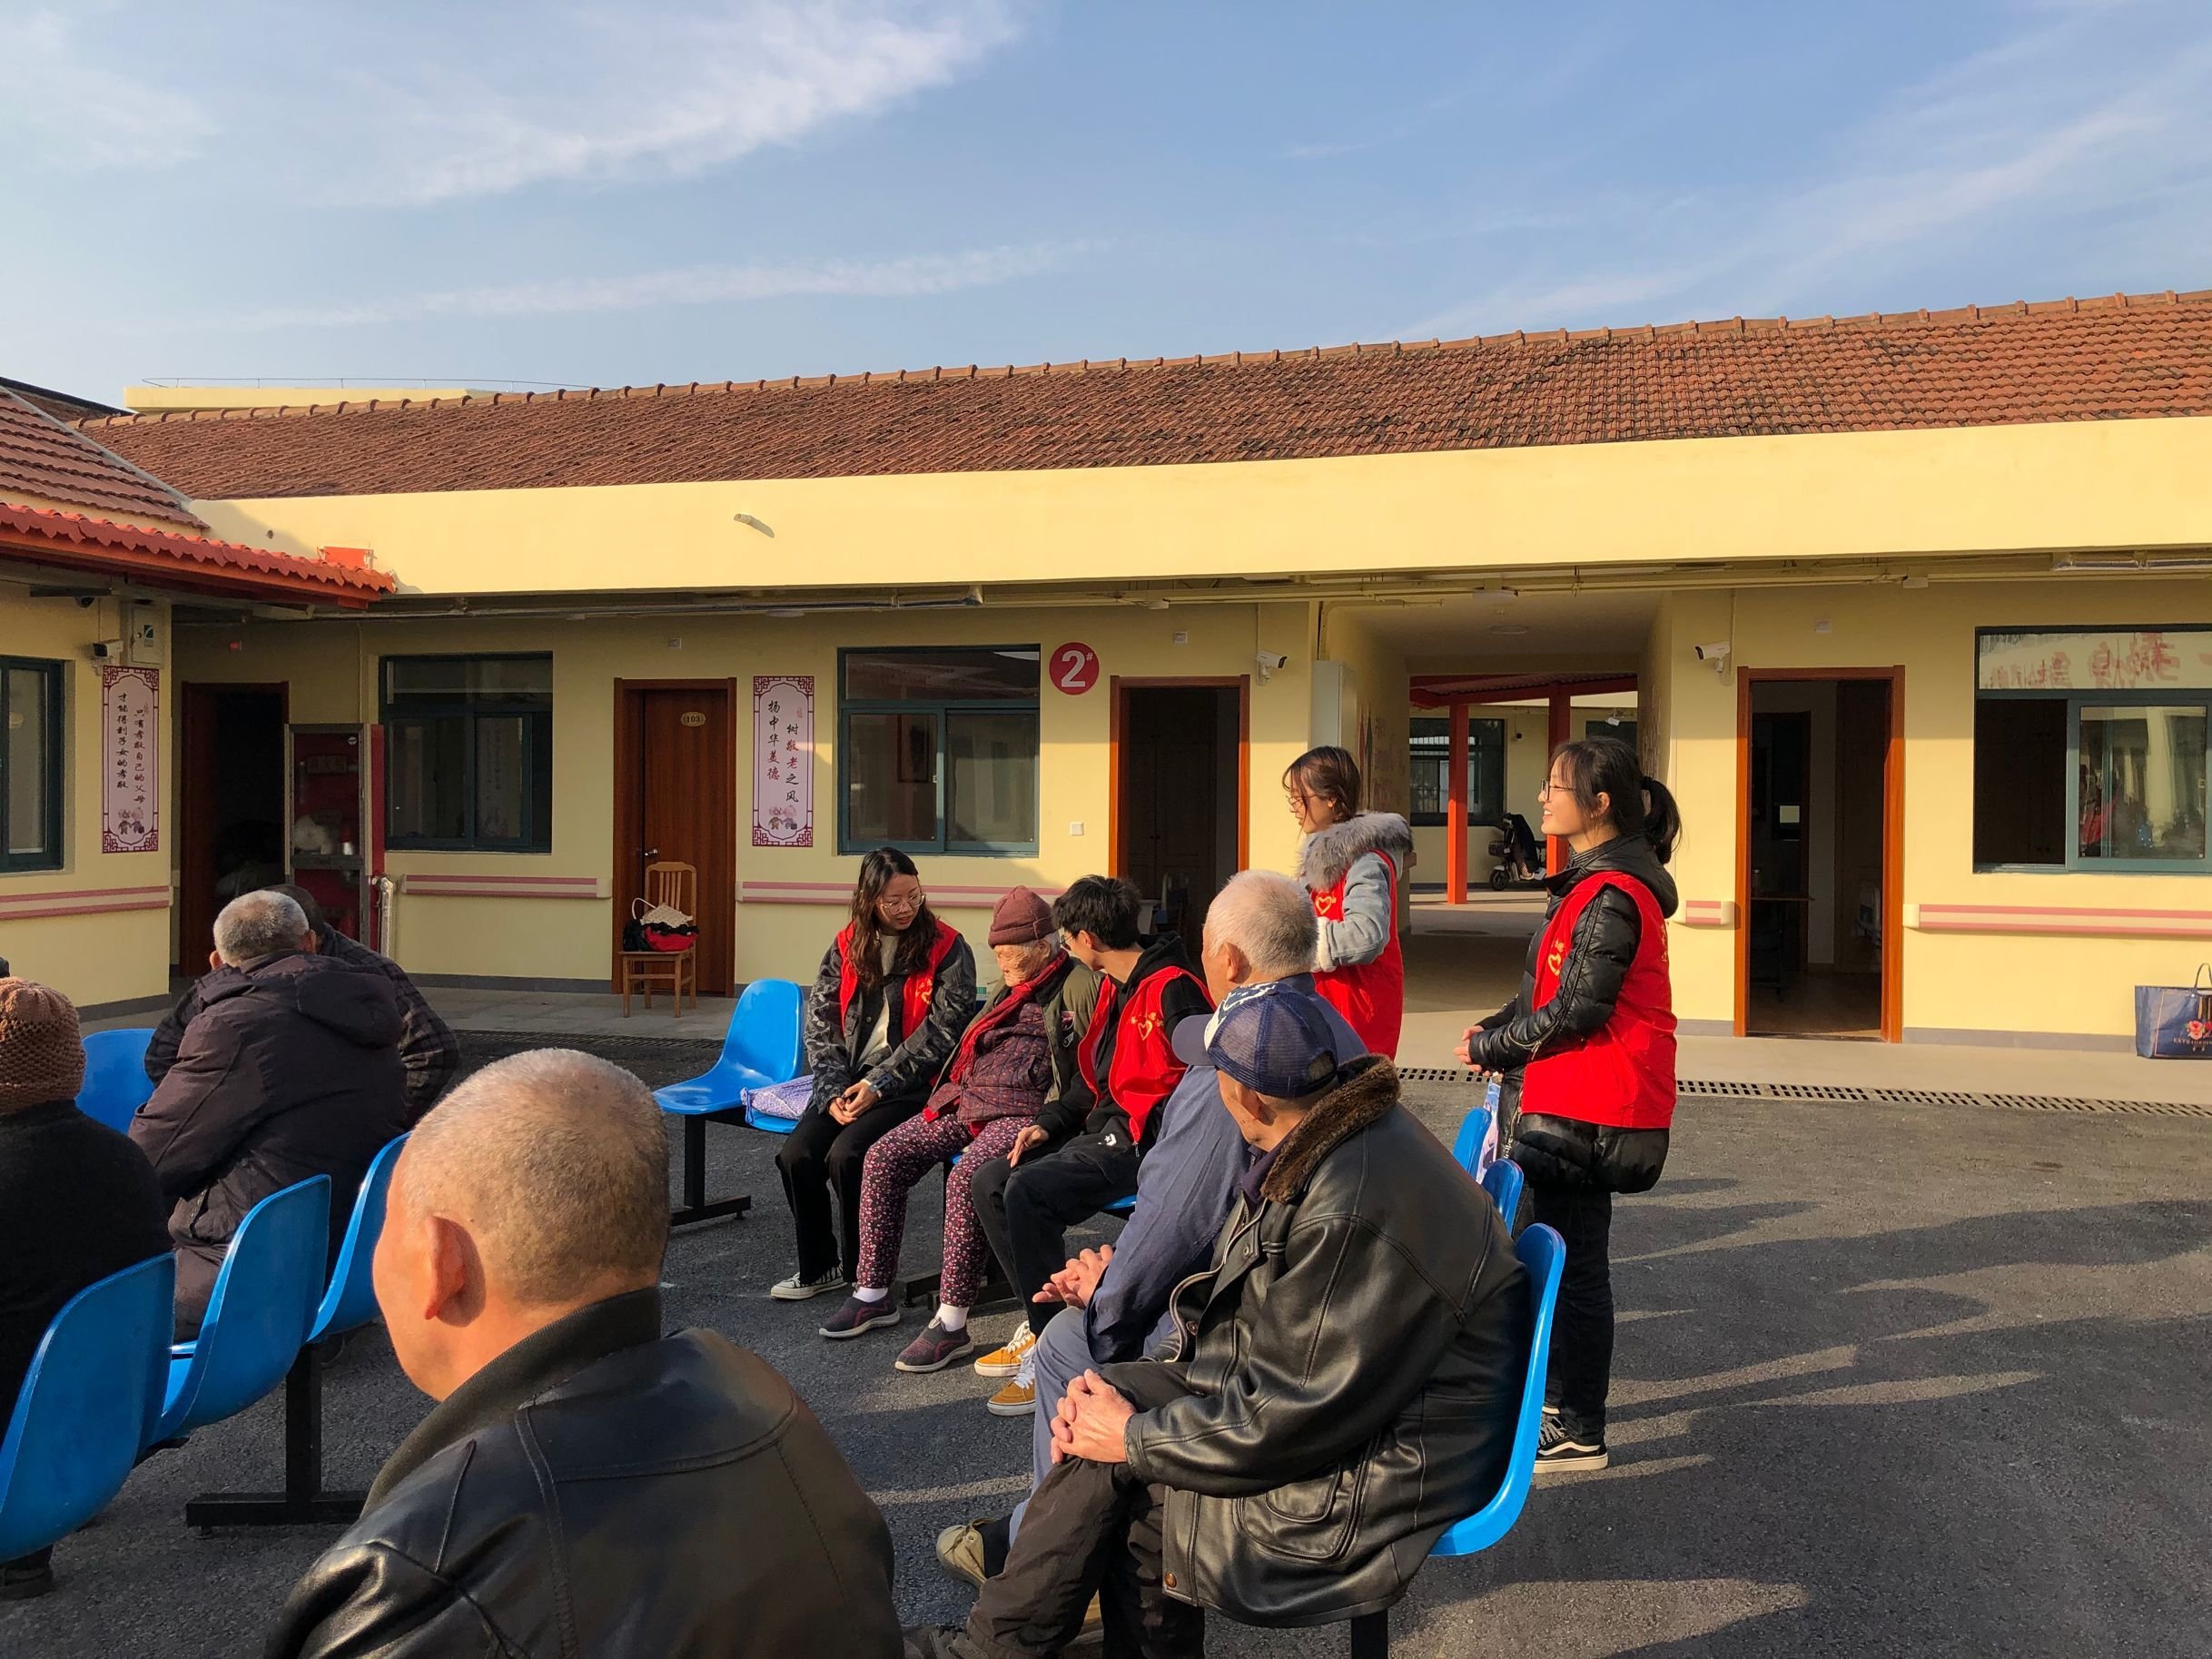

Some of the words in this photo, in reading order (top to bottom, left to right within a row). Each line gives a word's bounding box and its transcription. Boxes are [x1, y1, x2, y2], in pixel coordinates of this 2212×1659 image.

[116, 693, 129, 789] 才能得到子女的孝敬
[133, 708, 146, 805] 只有孝敬自己的父母
[767, 700, 780, 781] 扬中华美德
[785, 724, 799, 803] 树敬老之风
